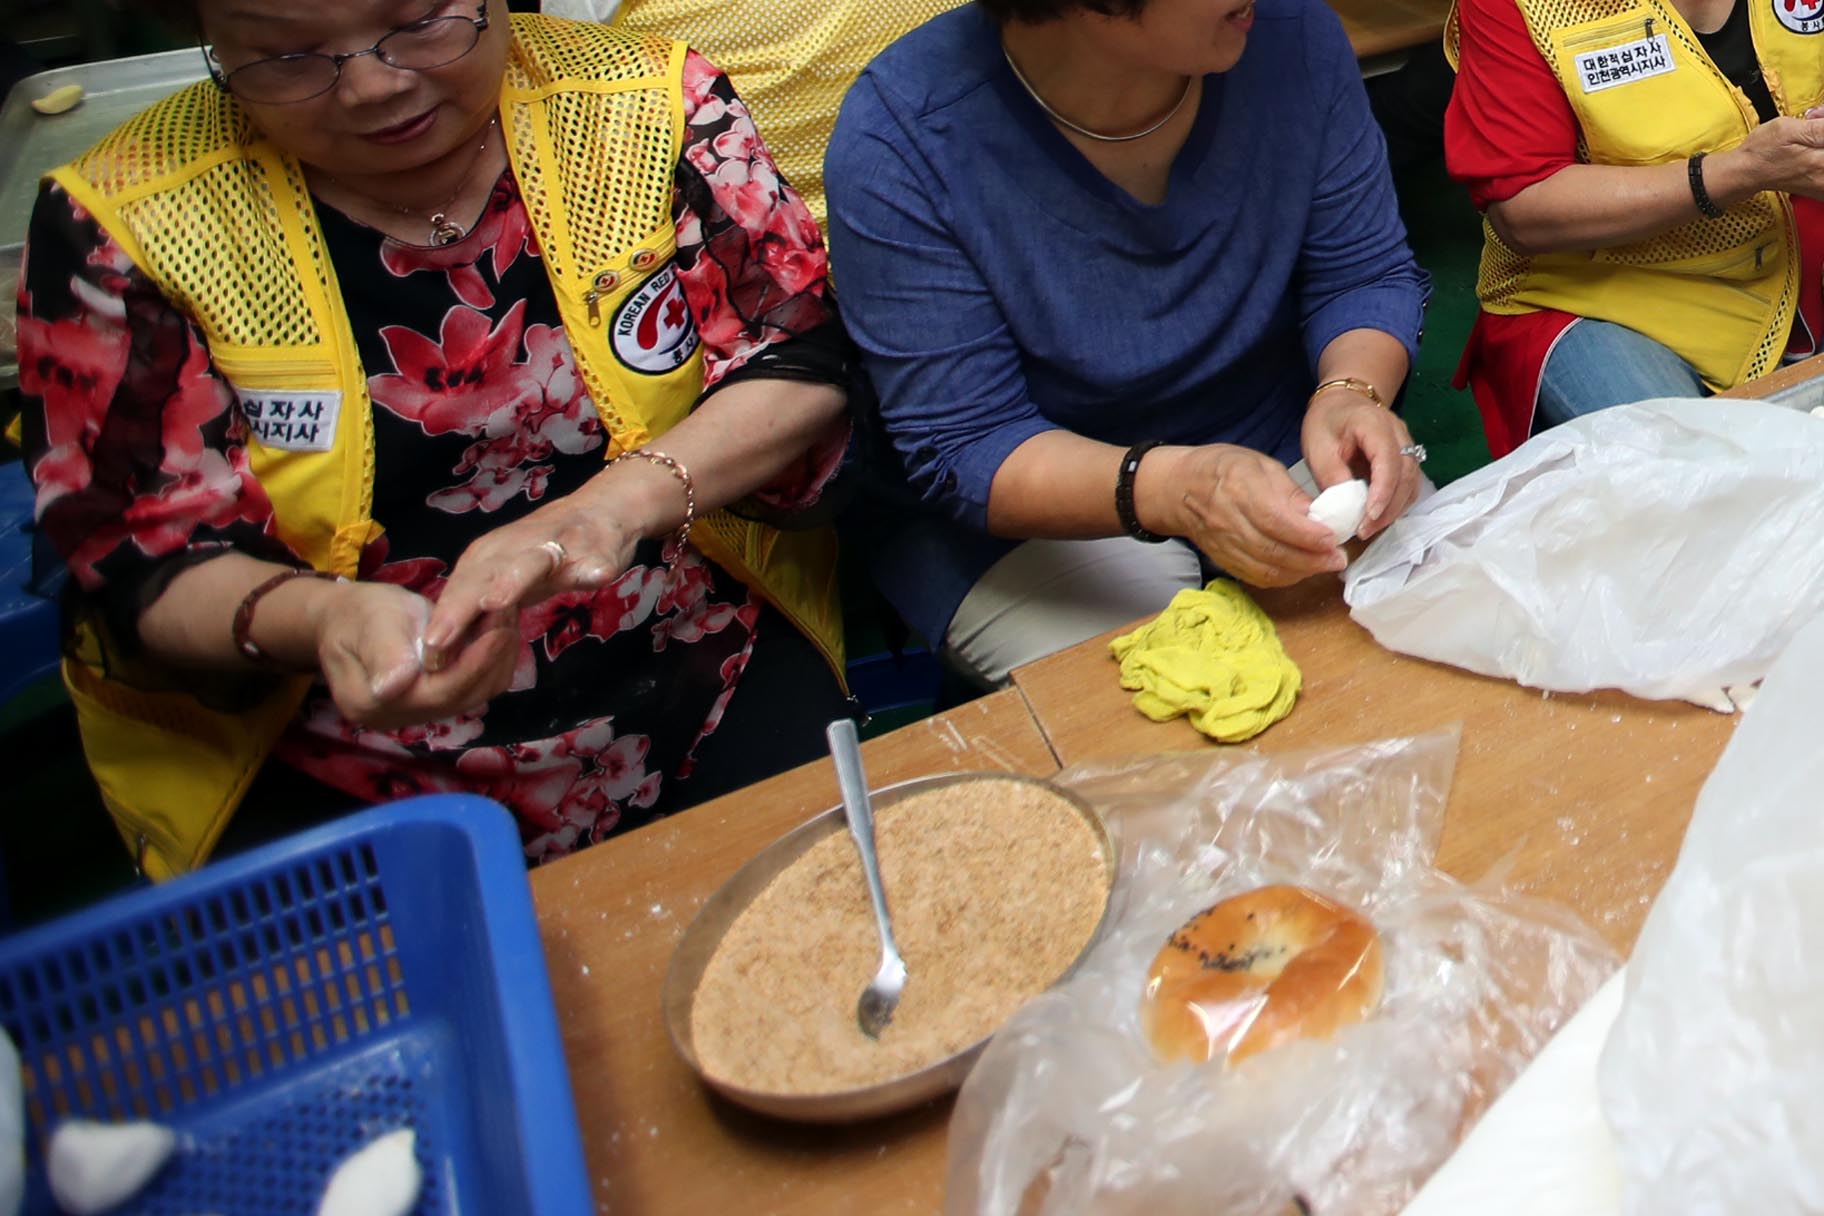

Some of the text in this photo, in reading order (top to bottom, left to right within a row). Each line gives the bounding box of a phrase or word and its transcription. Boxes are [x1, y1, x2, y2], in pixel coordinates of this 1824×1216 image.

[1583, 42, 1662, 72] 대한적십자사
[1587, 55, 1666, 86] 인천광역시지사
[617, 272, 671, 337] KOREAN RED
